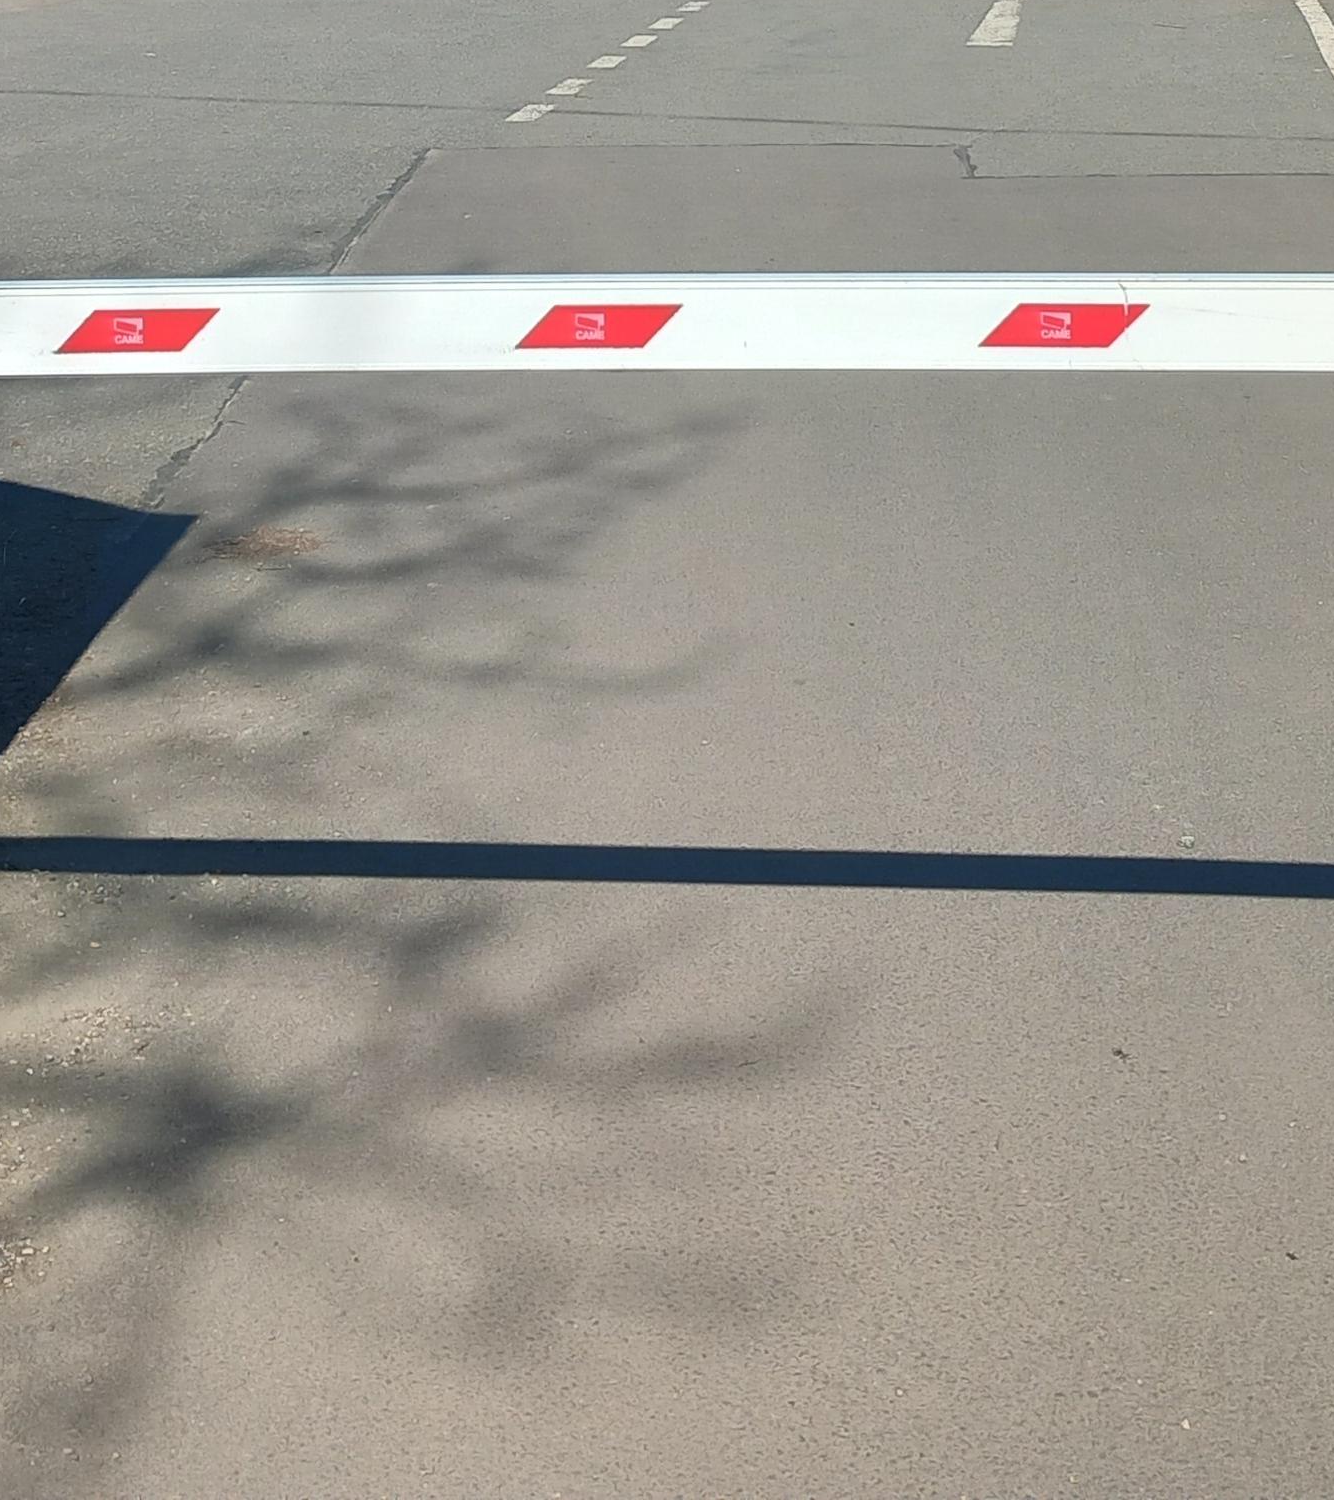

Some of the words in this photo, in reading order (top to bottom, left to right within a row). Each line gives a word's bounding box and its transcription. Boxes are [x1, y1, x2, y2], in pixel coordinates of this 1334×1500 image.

[575, 331, 604, 340] CAME
[1041, 329, 1071, 339] CAME
[115, 335, 143, 344] CAME
